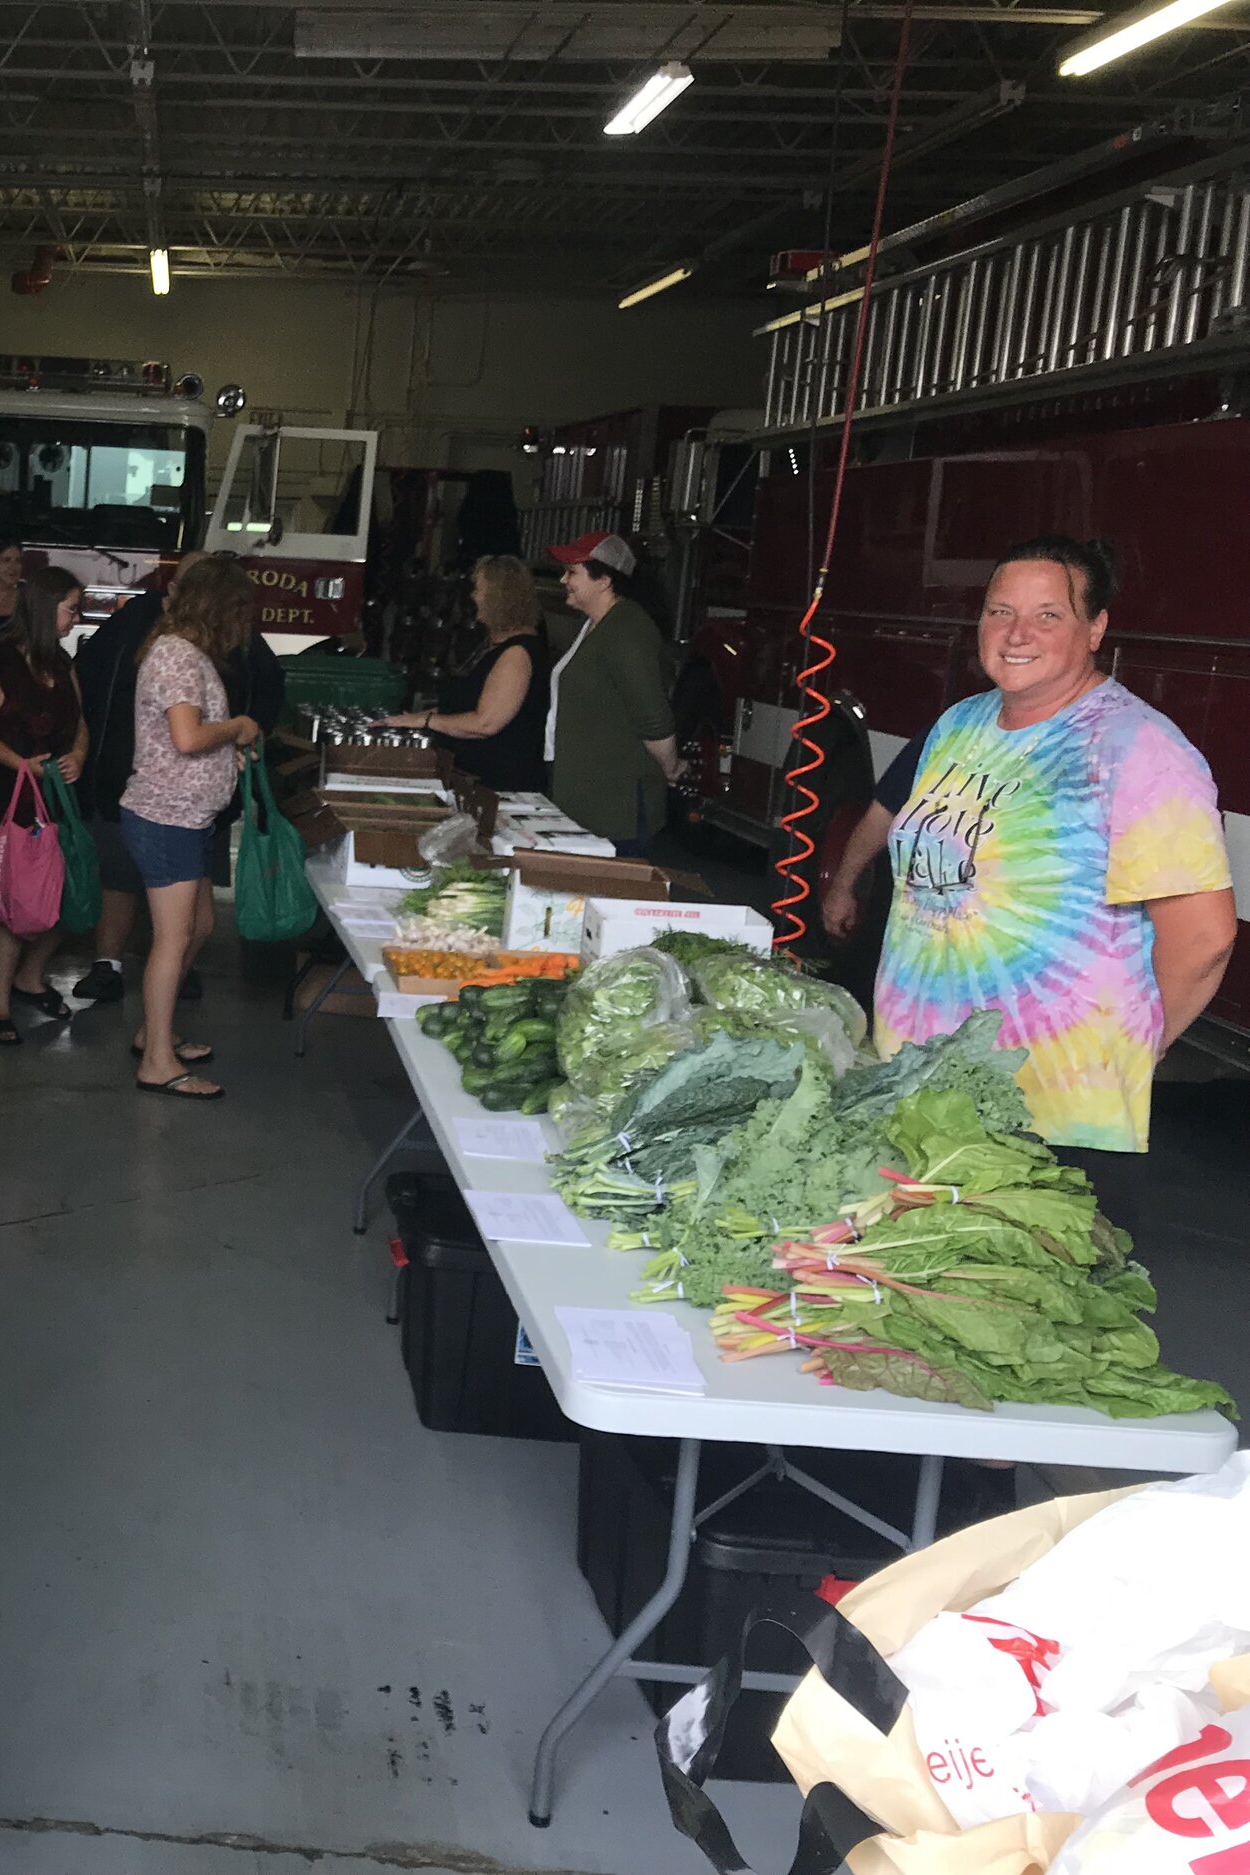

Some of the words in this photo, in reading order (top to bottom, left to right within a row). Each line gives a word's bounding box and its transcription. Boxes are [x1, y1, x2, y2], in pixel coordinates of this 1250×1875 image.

[262, 607, 314, 624] DEPT.
[929, 762, 1021, 808] Live
[899, 799, 994, 849] Love
